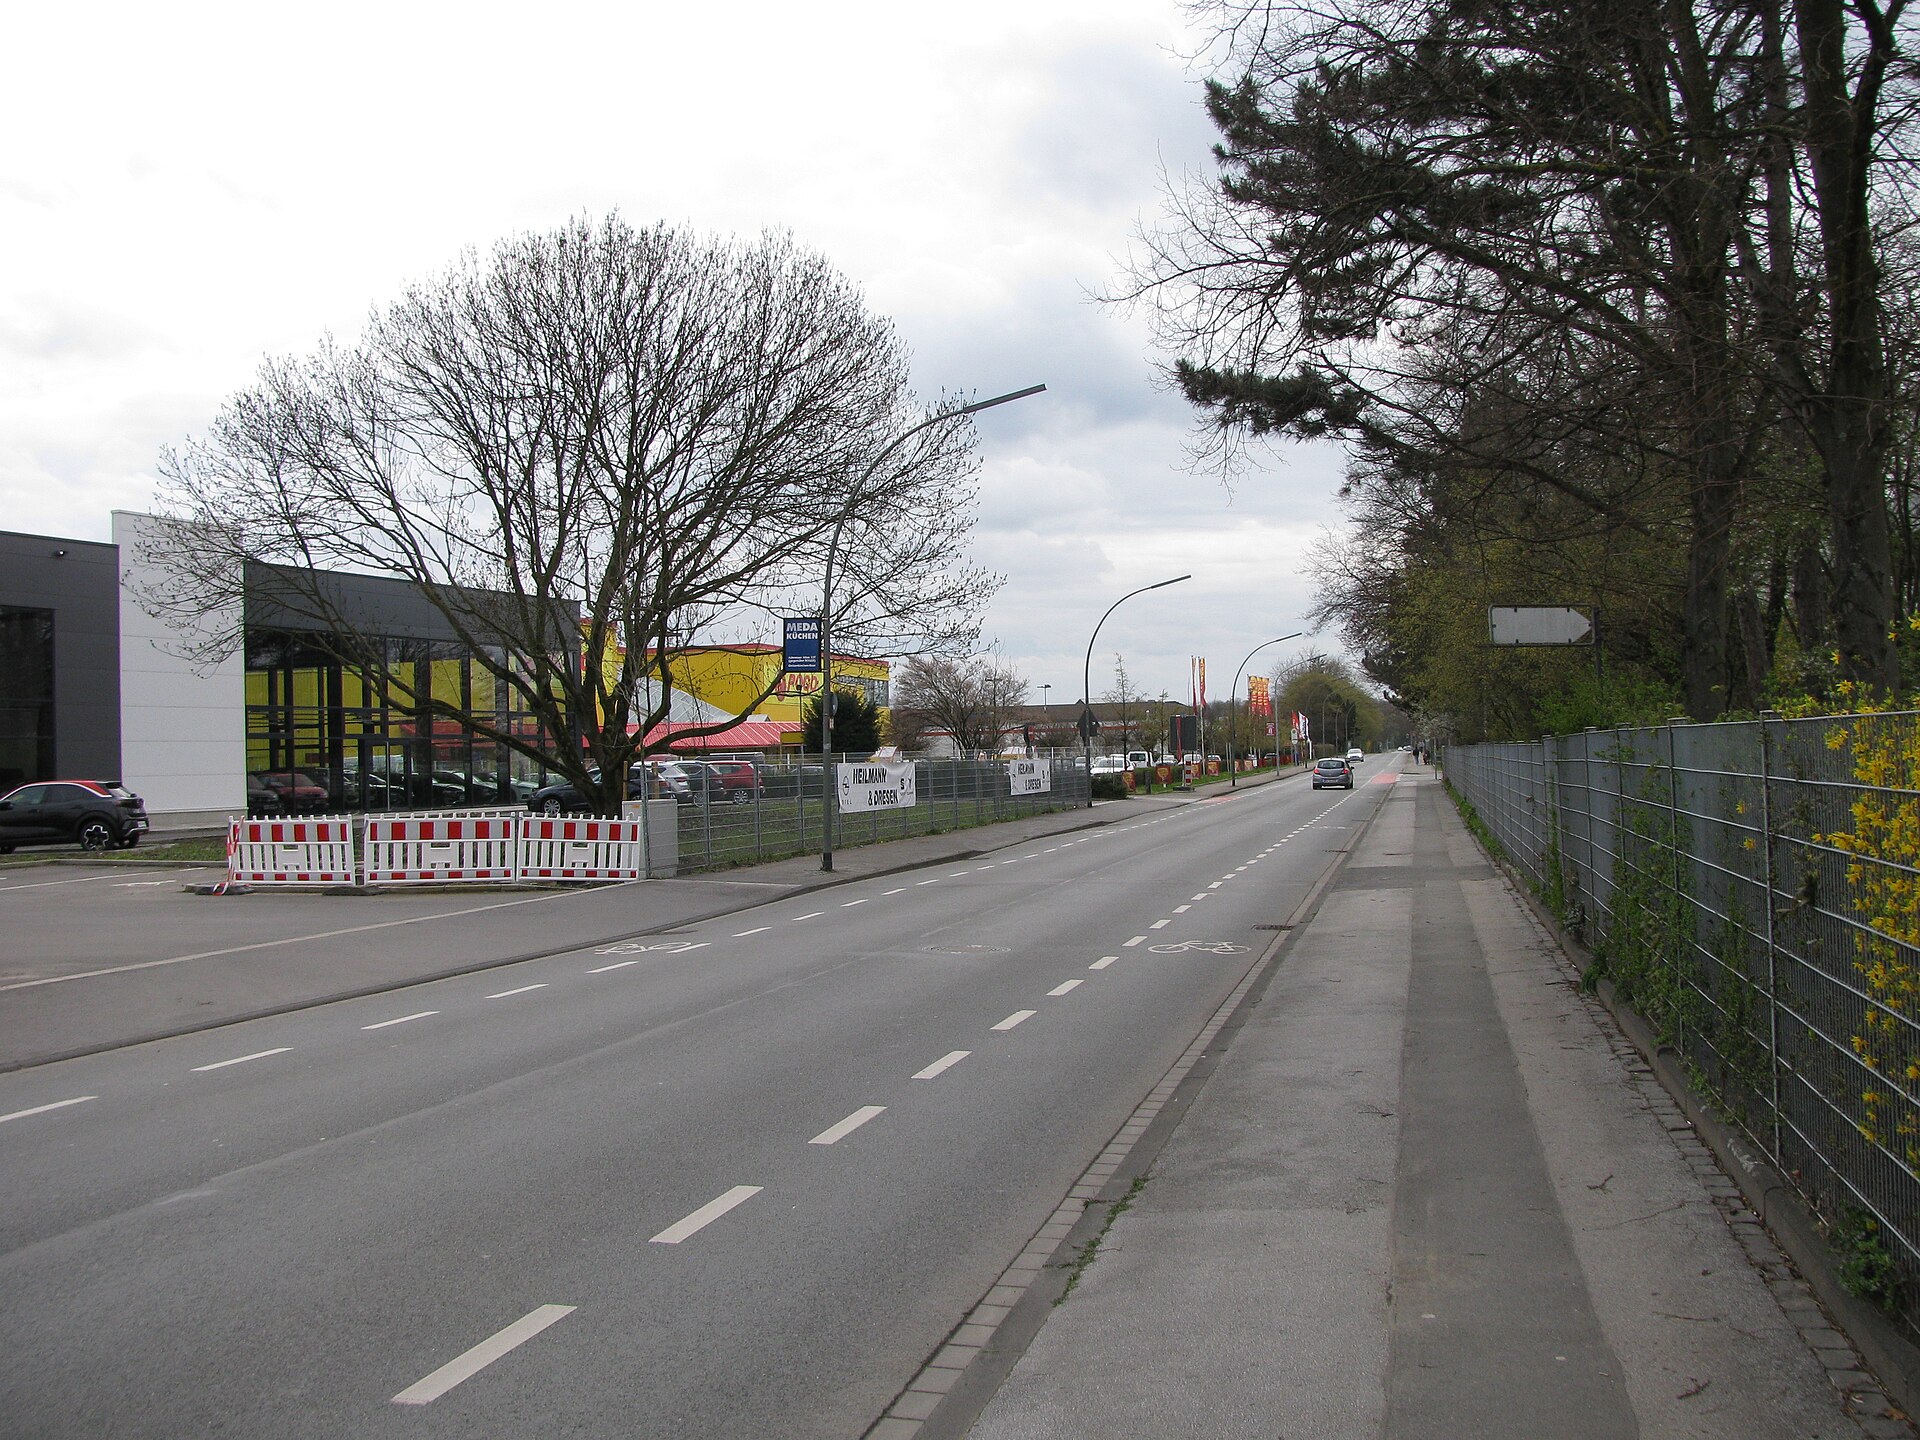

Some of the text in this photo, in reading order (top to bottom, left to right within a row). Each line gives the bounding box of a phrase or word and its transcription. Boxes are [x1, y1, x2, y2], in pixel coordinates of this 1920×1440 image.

[786, 622, 818, 632] MEDA
[786, 632, 818, 640] KÜCHEN
[852, 768, 887, 785] HEILMANN
[867, 789, 899, 806] & DRESEN
